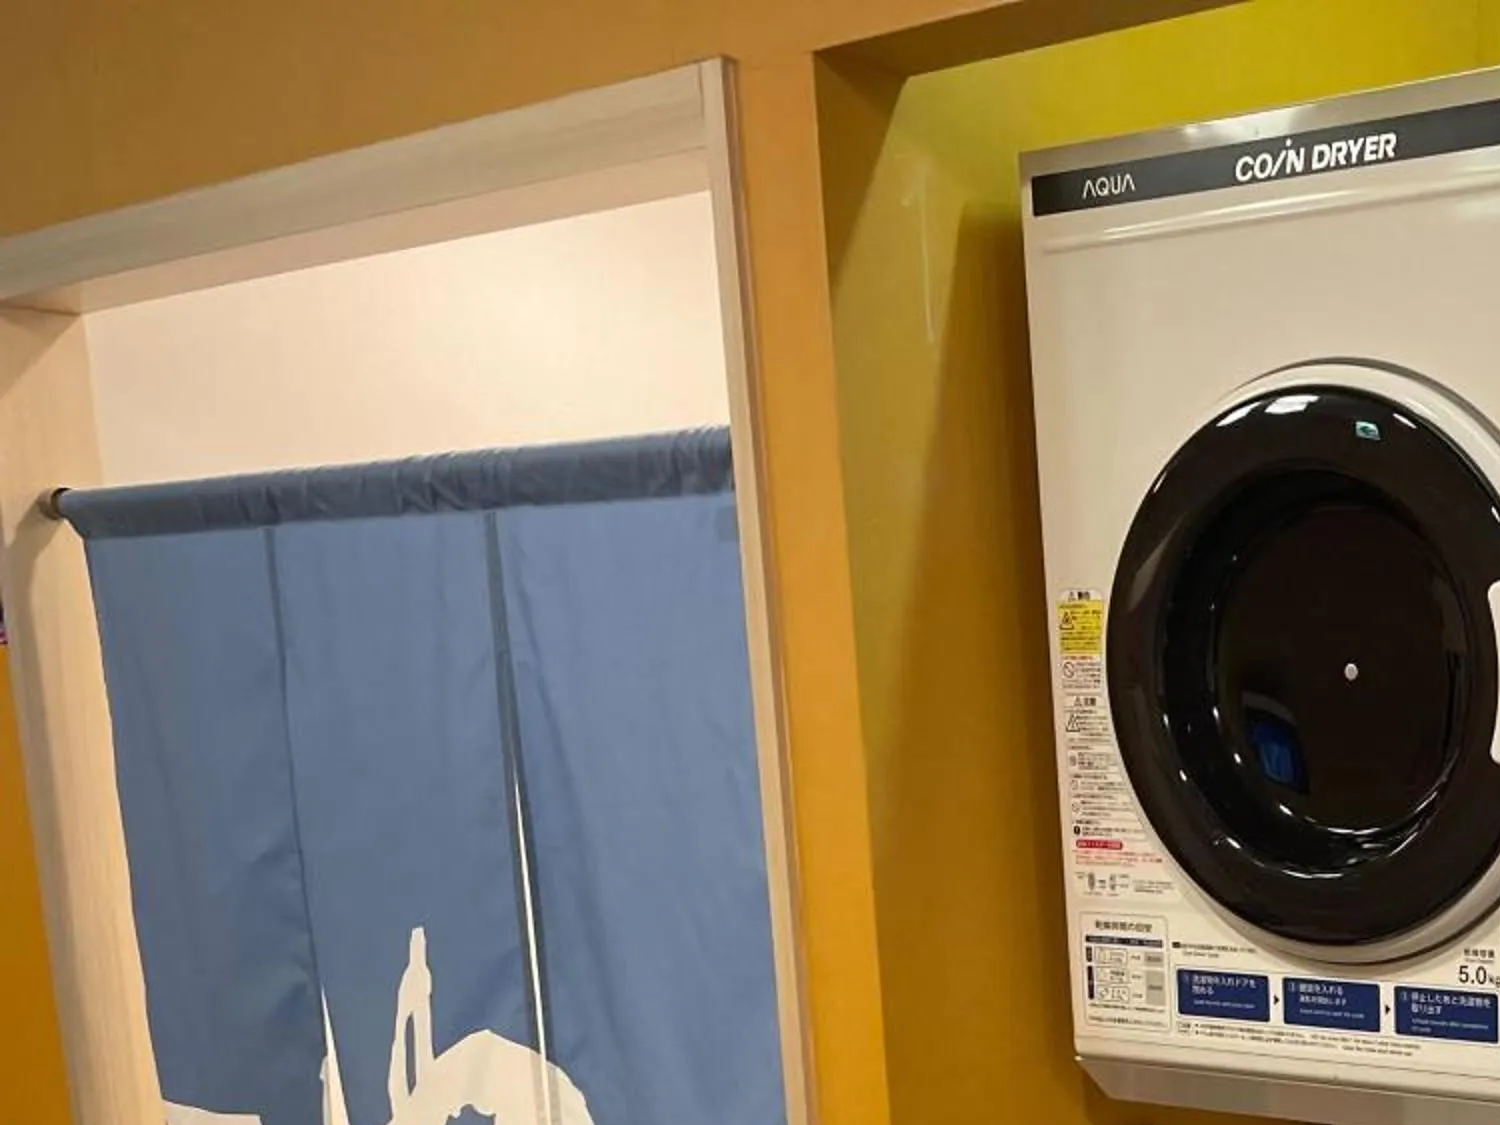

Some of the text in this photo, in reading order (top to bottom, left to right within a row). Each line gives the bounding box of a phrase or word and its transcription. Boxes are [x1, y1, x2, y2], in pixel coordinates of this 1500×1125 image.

[1235, 131, 1397, 182] COIN DRYER
[1082, 173, 1136, 199] AQUA
